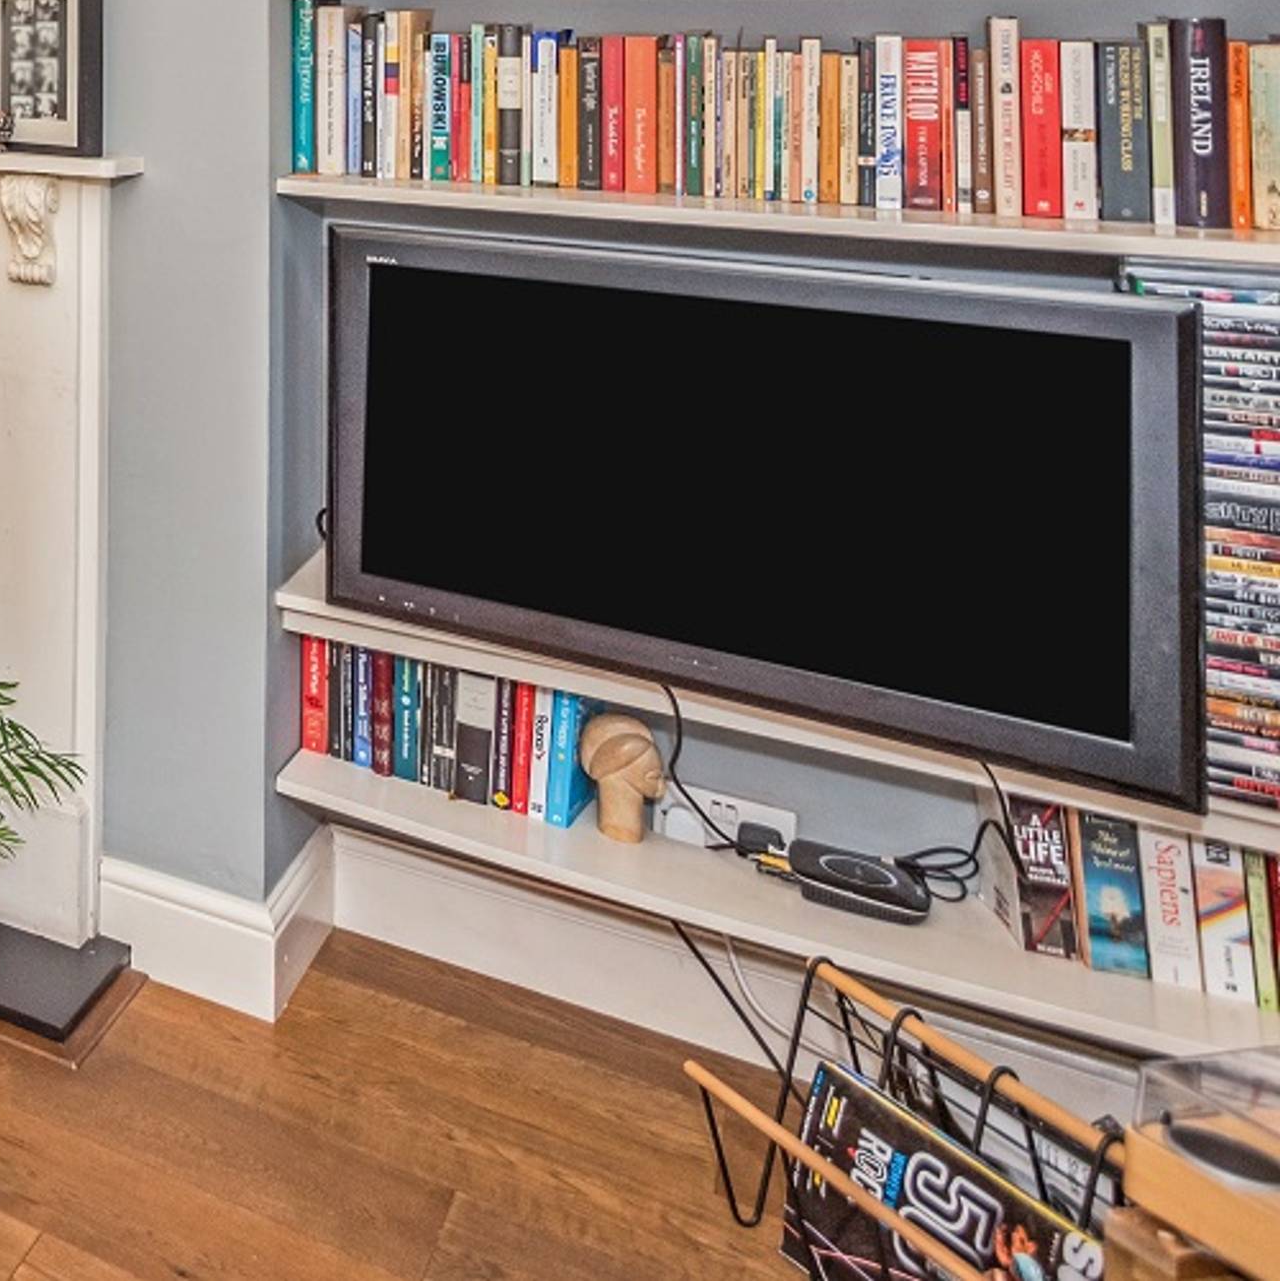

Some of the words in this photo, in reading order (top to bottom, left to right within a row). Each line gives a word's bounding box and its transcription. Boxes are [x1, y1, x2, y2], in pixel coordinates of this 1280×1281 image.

[300, 55, 314, 104] THOMAS
[432, 41, 448, 130] BUKOWSKI
[880, 74, 898, 122] FRANCE
[906, 50, 939, 121] WATERLOO
[1189, 56, 1213, 156] IRELAND
[1120, 138, 1133, 172] CLASS
[1013, 824, 1062, 845] LITTLE
[1029, 814, 1041, 827] A
[1016, 840, 1065, 866] LIFE
[1149, 839, 1182, 926] Sapiens
